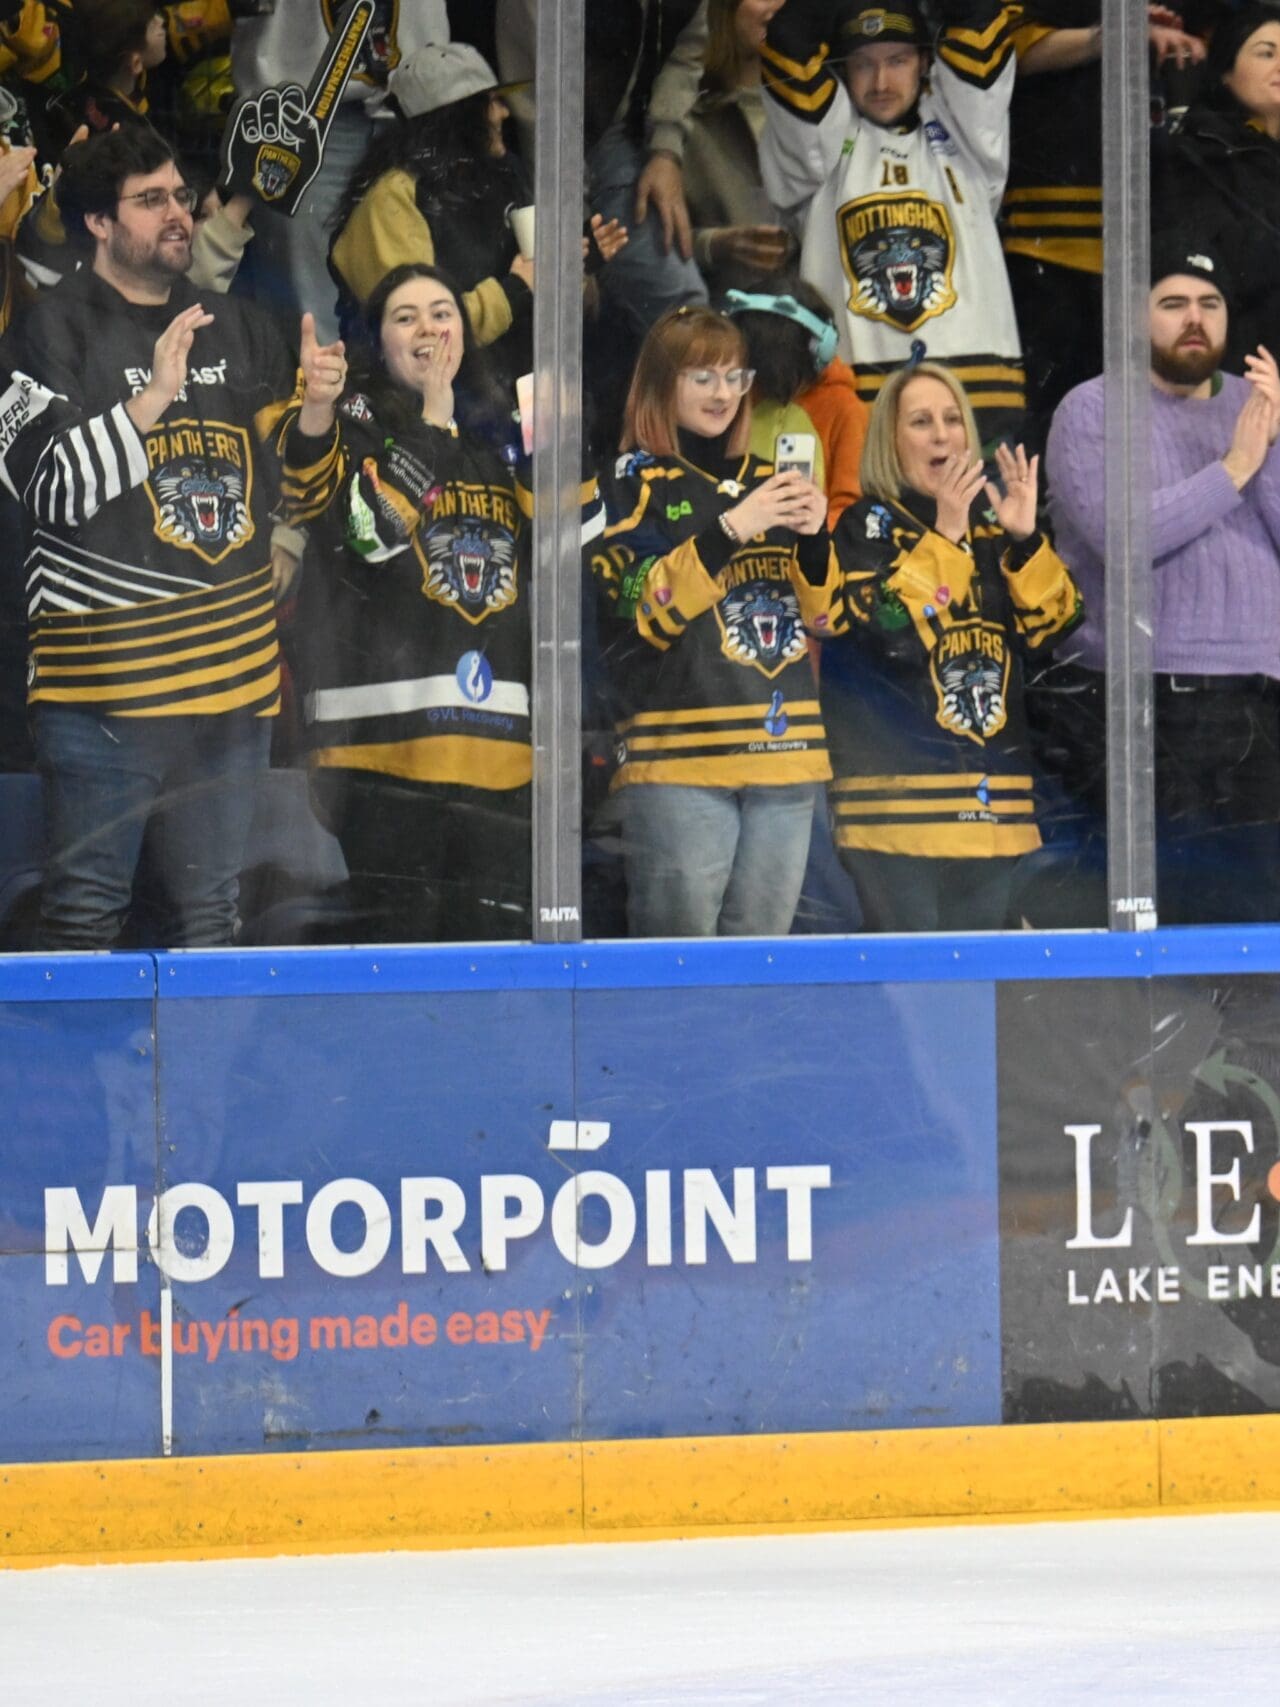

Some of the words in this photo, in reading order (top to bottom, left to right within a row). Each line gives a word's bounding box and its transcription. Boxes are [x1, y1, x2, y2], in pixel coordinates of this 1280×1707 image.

[880, 159, 909, 187] 18
[146, 430, 242, 471] PANTHERS
[432, 490, 515, 531] ANTHERS
[721, 556, 791, 590] PANTHER
[427, 708, 459, 723] GVL
[44, 1164, 831, 1286] MOTORPOINT
[1068, 1266, 1180, 1305] LAKE
[47, 1313, 131, 1359] Car
[139, 1309, 299, 1363] buying
[309, 1301, 438, 1350] made
[446, 1309, 552, 1352] easy
